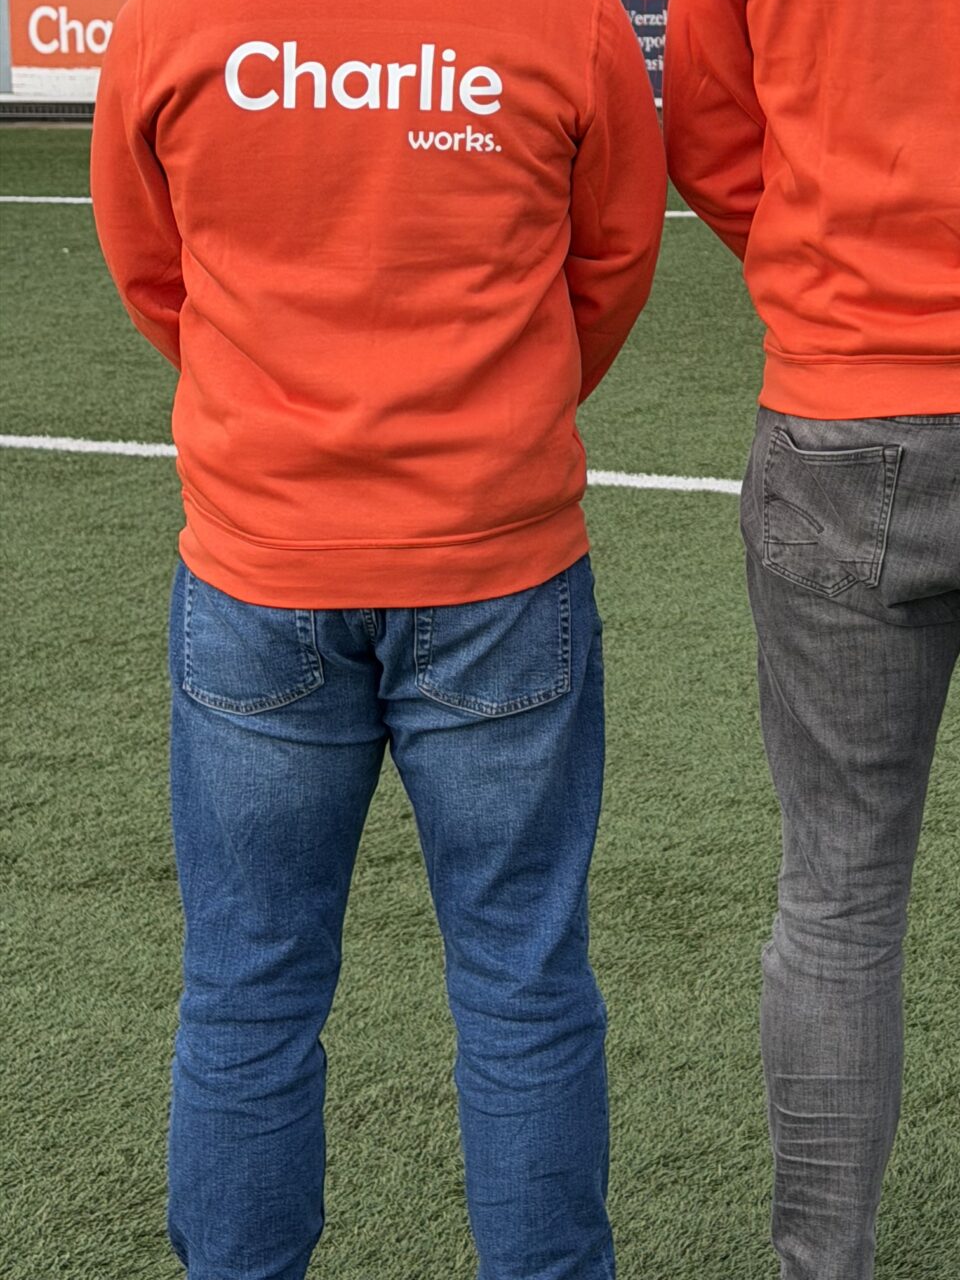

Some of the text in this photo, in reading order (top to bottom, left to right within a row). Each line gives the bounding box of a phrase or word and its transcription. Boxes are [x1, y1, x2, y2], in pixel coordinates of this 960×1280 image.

[28, 6, 114, 55] Cha
[224, 40, 503, 116] Charlie
[408, 125, 502, 152] works.
